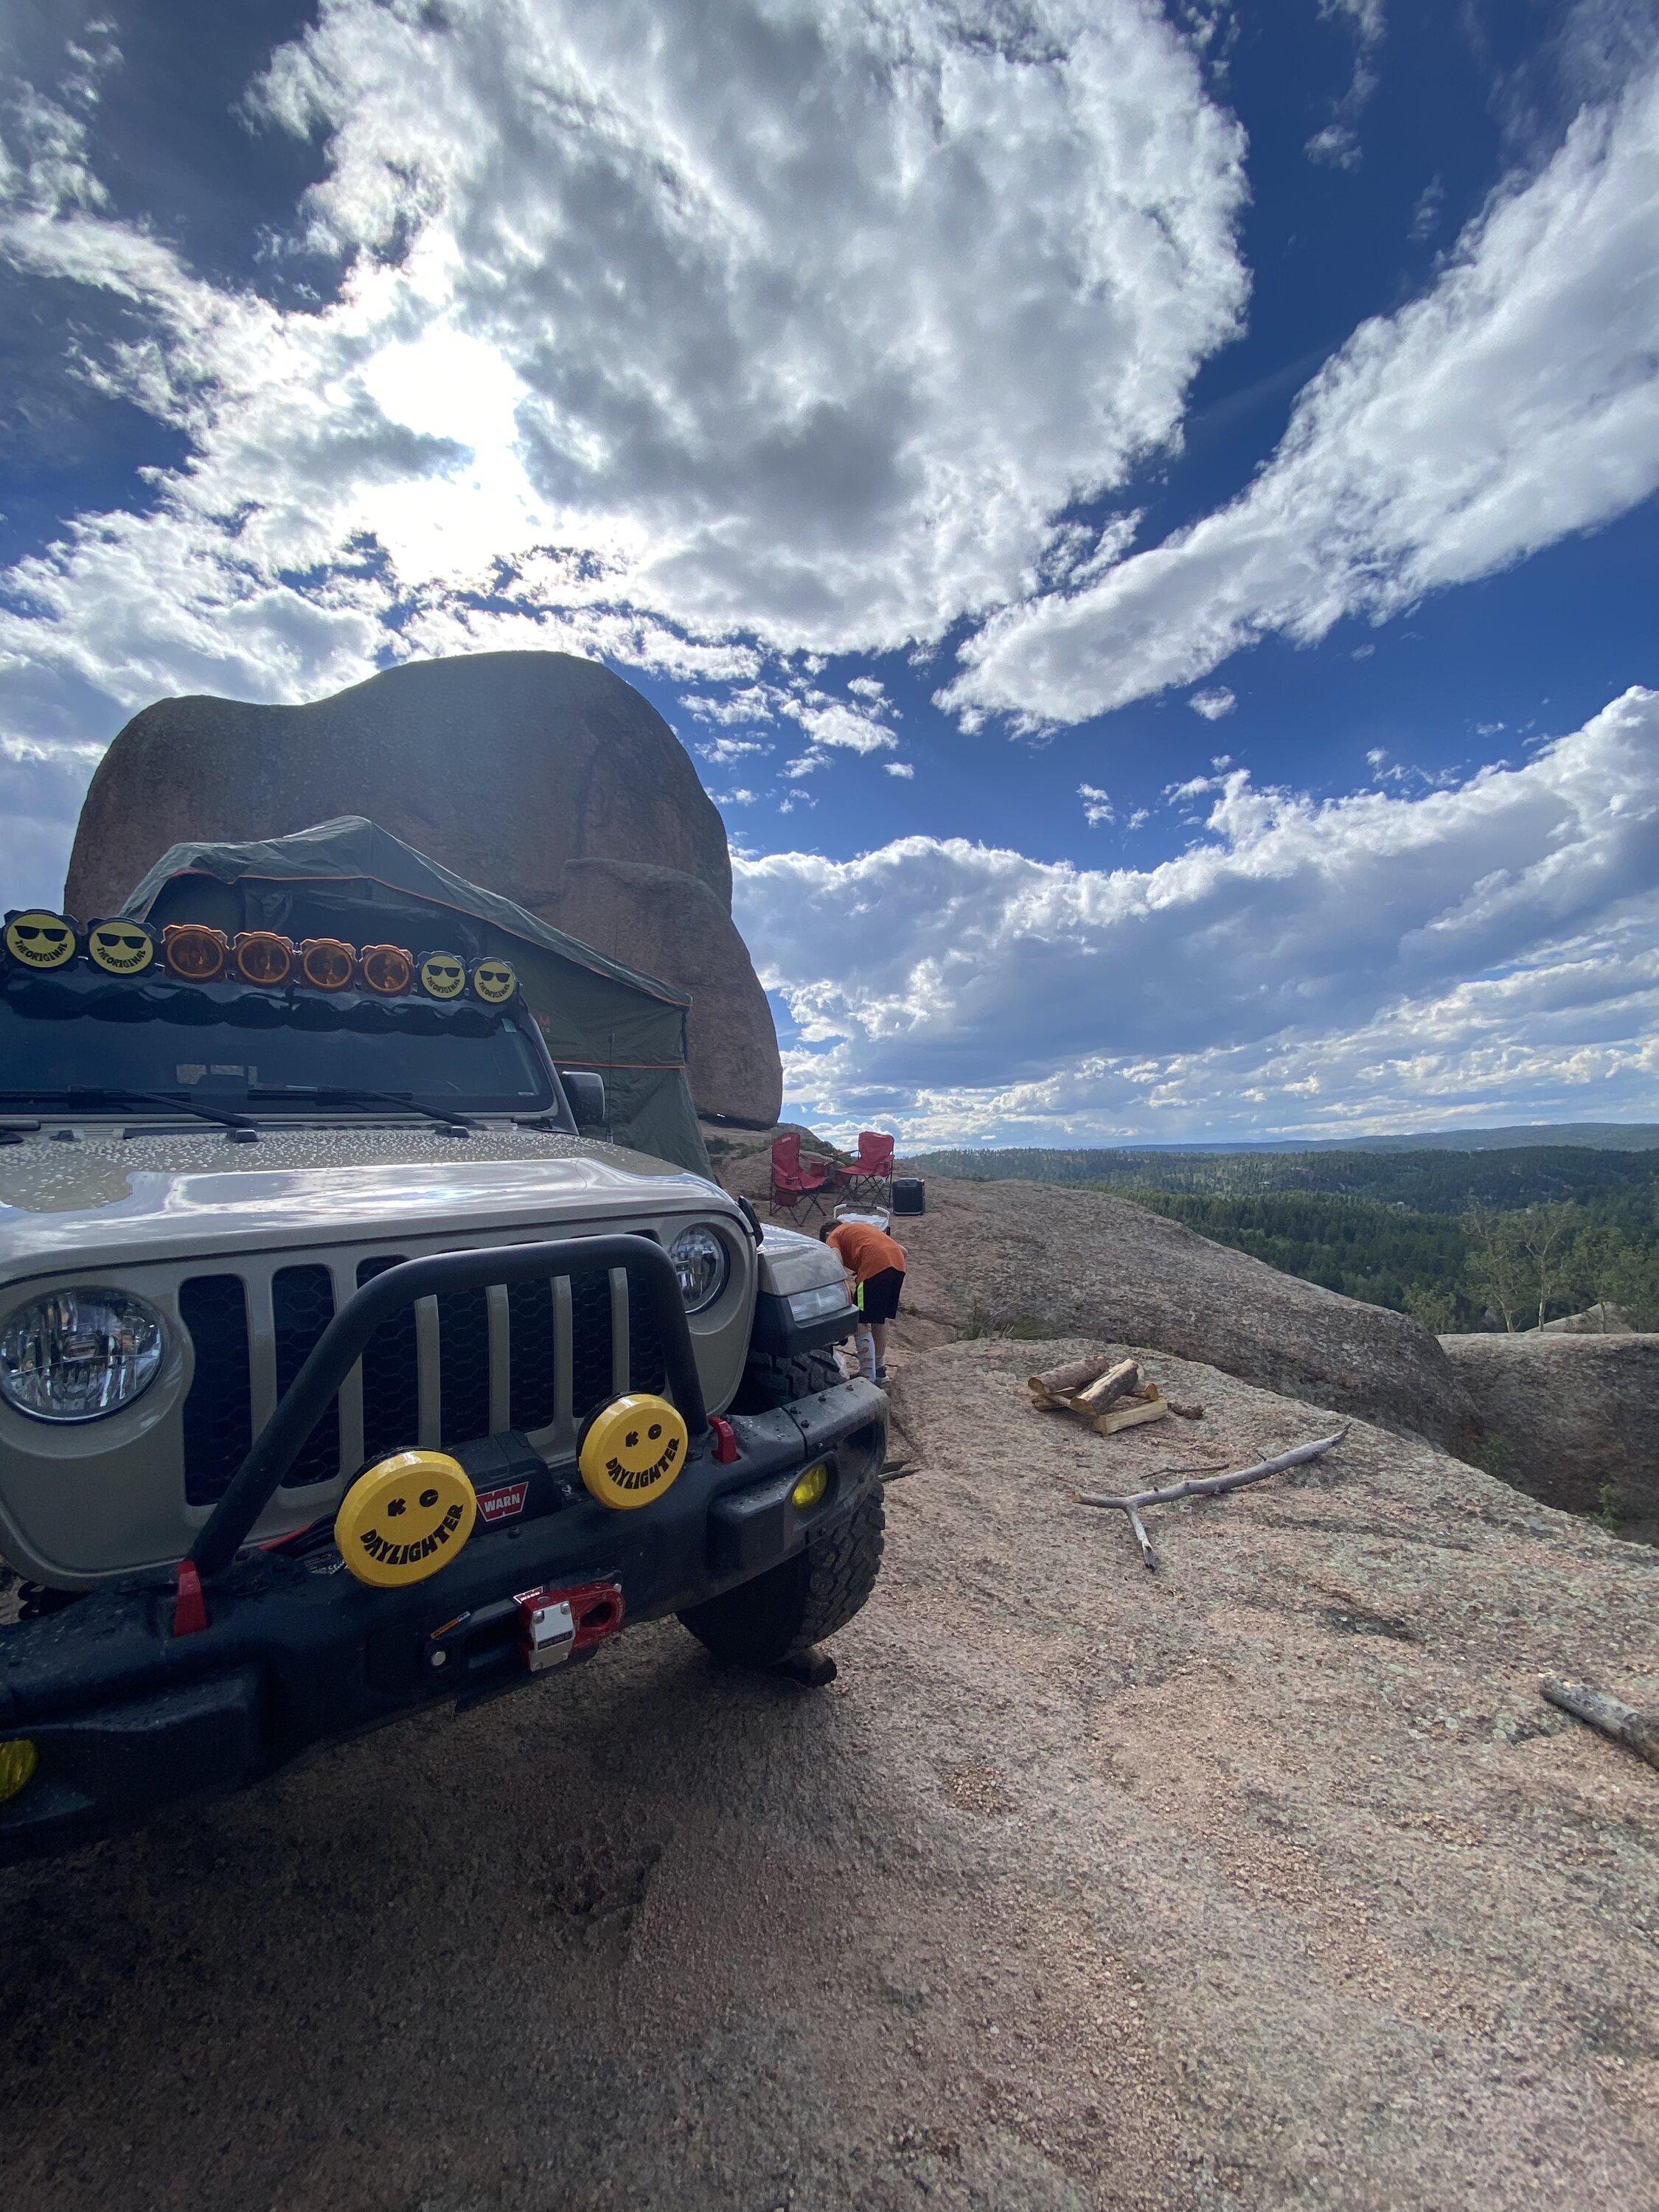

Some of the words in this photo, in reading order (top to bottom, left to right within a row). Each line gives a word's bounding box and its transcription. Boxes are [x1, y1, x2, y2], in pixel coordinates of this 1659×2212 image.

[15, 940, 29, 953] THE
[25, 943, 68, 961] ORIGINAL
[107, 950, 146, 967] ORIGINAL
[605, 1438, 679, 1489] DAYLIGHTER
[484, 1492, 521, 1512] WARN
[360, 1504, 465, 1565] DAYLIGHTER
